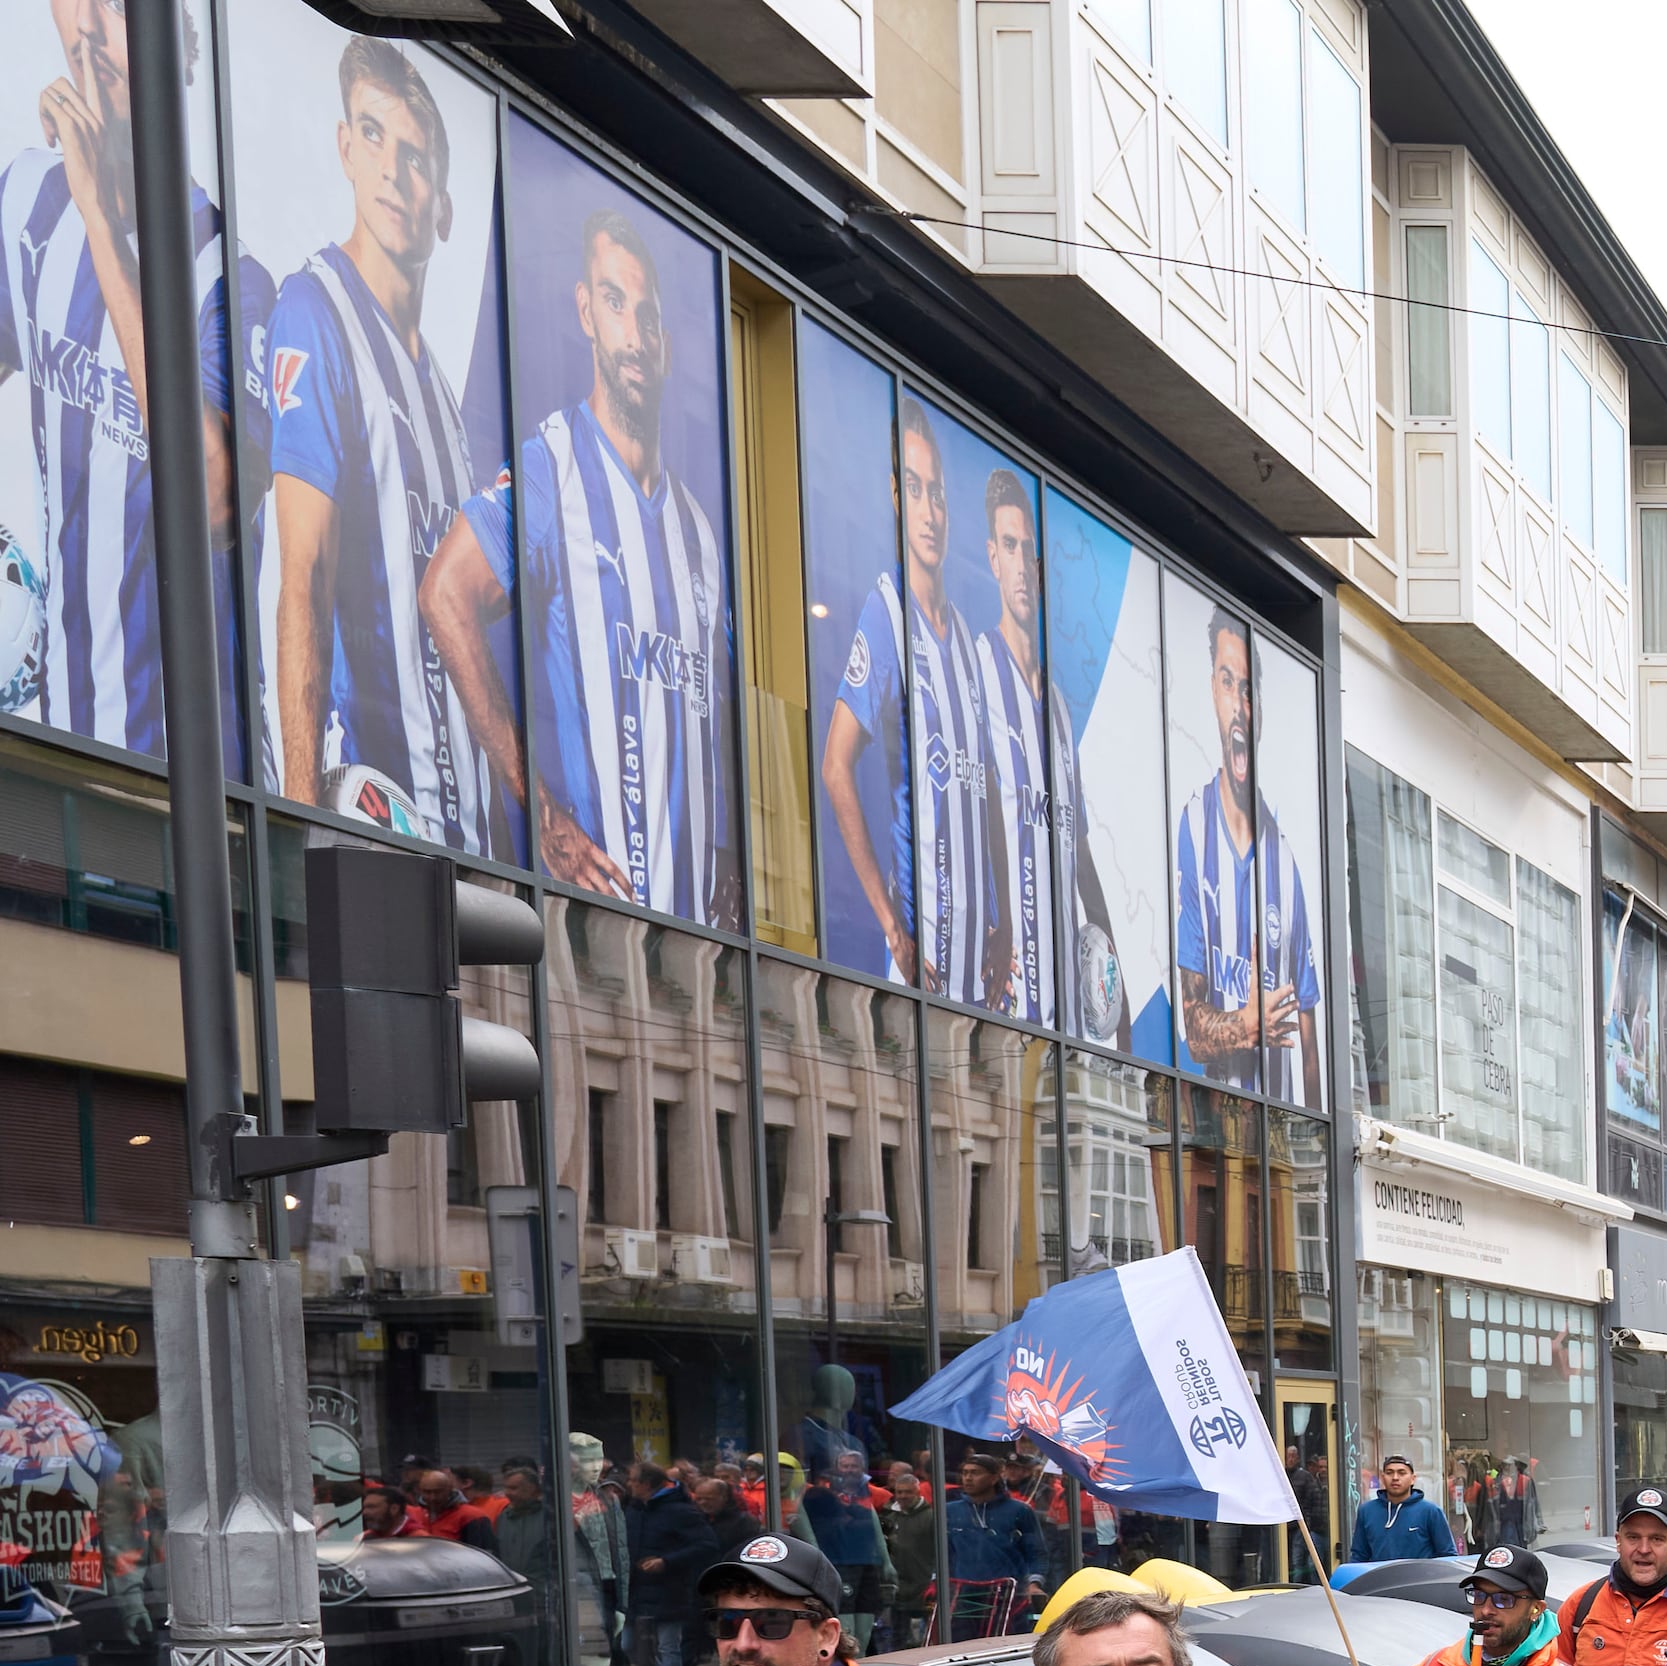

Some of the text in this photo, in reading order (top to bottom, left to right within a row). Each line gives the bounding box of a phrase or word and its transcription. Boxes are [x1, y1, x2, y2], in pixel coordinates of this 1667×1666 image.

[101, 420, 148, 461] NEWS
[436, 731, 458, 823] araba
[622, 713, 642, 805] álava
[1021, 856, 1038, 1003] araba álava
[1481, 989, 1504, 1026] PASO
[1482, 1024, 1495, 1056] DE
[1483, 1058, 1512, 1096] CEBRA
[1375, 1180, 1466, 1231] CONTIENE FELICIDAD,
[0, 1509, 101, 1556] ASKON
[57, 1560, 102, 1585] GASTEIZ
